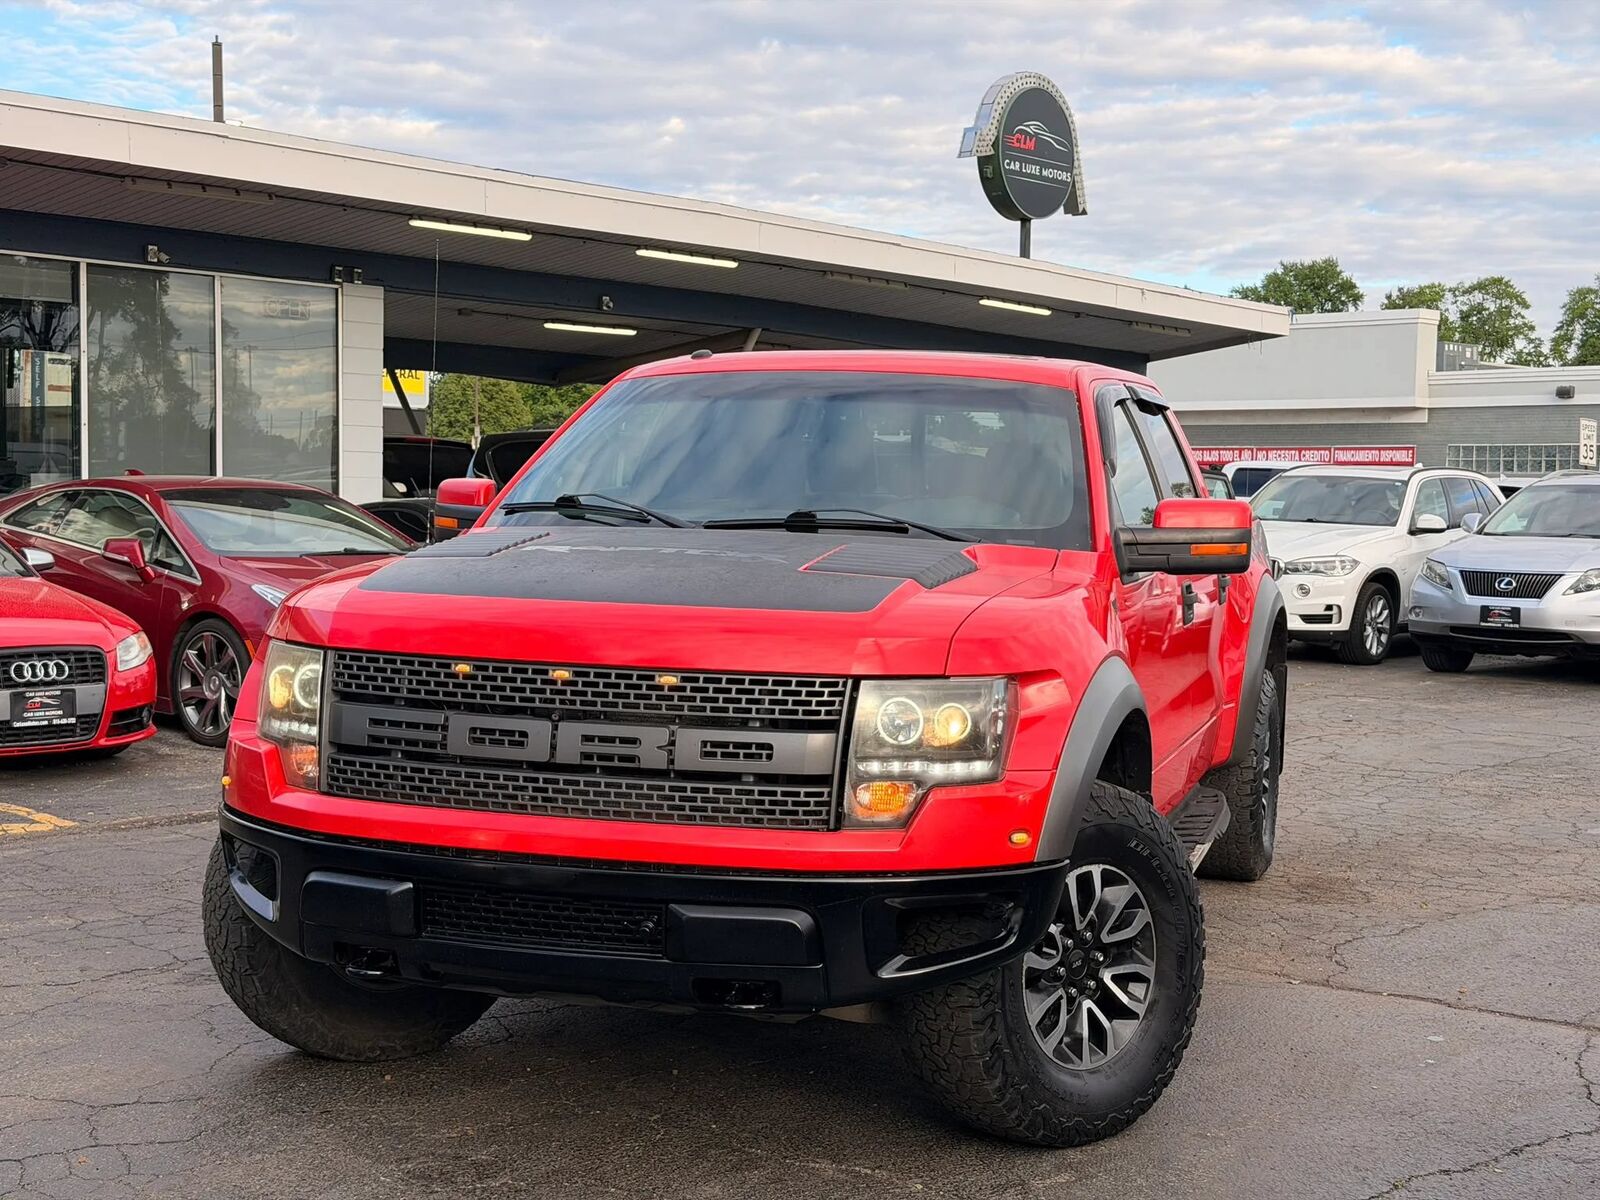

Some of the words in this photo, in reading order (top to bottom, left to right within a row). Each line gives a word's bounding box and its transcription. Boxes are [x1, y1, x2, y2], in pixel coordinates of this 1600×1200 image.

[1013, 133, 1036, 150] CLM
[1004, 159, 1020, 172] CAR
[1022, 162, 1040, 176] LUXE
[1042, 167, 1071, 182] MOTORS
[1203, 450, 1219, 462] BAJOS
[1220, 450, 1233, 462] TODO
[1234, 450, 1240, 462] EL
[1257, 450, 1267, 461] NO
[1268, 450, 1299, 462] NECESITA
[1300, 450, 1330, 462] CREDITO
[1334, 450, 1379, 462] FINANCIAMIENTO
[1380, 450, 1413, 462] DISPONIBLE
[1582, 443, 1595, 460] 35
[329, 701, 838, 775] FORD
